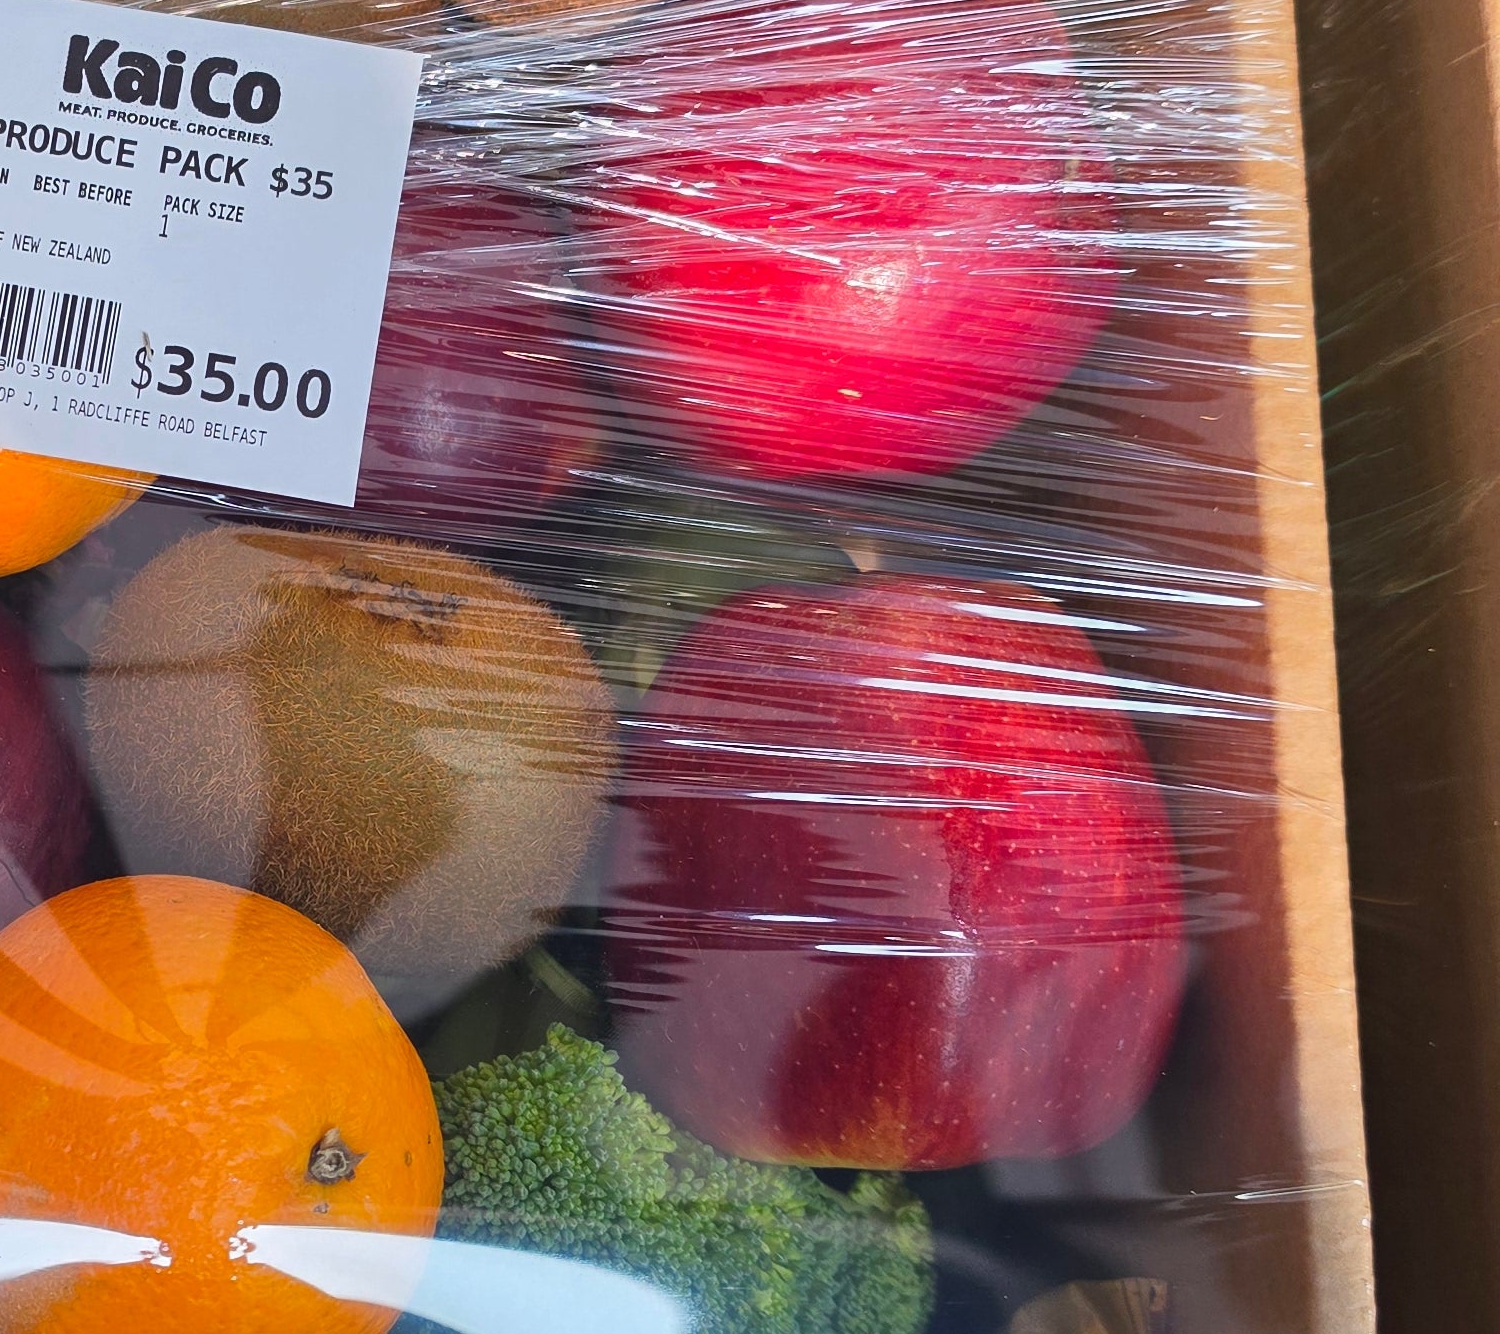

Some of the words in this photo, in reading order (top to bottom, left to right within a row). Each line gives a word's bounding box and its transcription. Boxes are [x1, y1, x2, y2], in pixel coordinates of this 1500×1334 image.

[62, 35, 282, 124] KaiCo
[59, 102, 102, 119] MEAT.
[107, 110, 182, 132] PRODUCE.
[187, 122, 274, 146] GROCERIES.
[33, 175, 70, 196] BEST
[77, 182, 133, 206] BEFORE
[159, 146, 249, 187] PACK
[269, 163, 334, 200] $35
[158, 215, 169, 238] 1
[163, 195, 200, 215] PACK
[207, 202, 245, 223] SIZE
[12, 233, 41, 253] NEW
[49, 240, 111, 265] ZEALAND
[131, 345, 332, 419] $35.00
[23, 391, 39, 411] J,
[51, 396, 59, 412] 1
[68, 398, 151, 428] RADCLIFFE
[158, 414, 195, 435] ROAD
[204, 422, 268, 446] BELFAST
